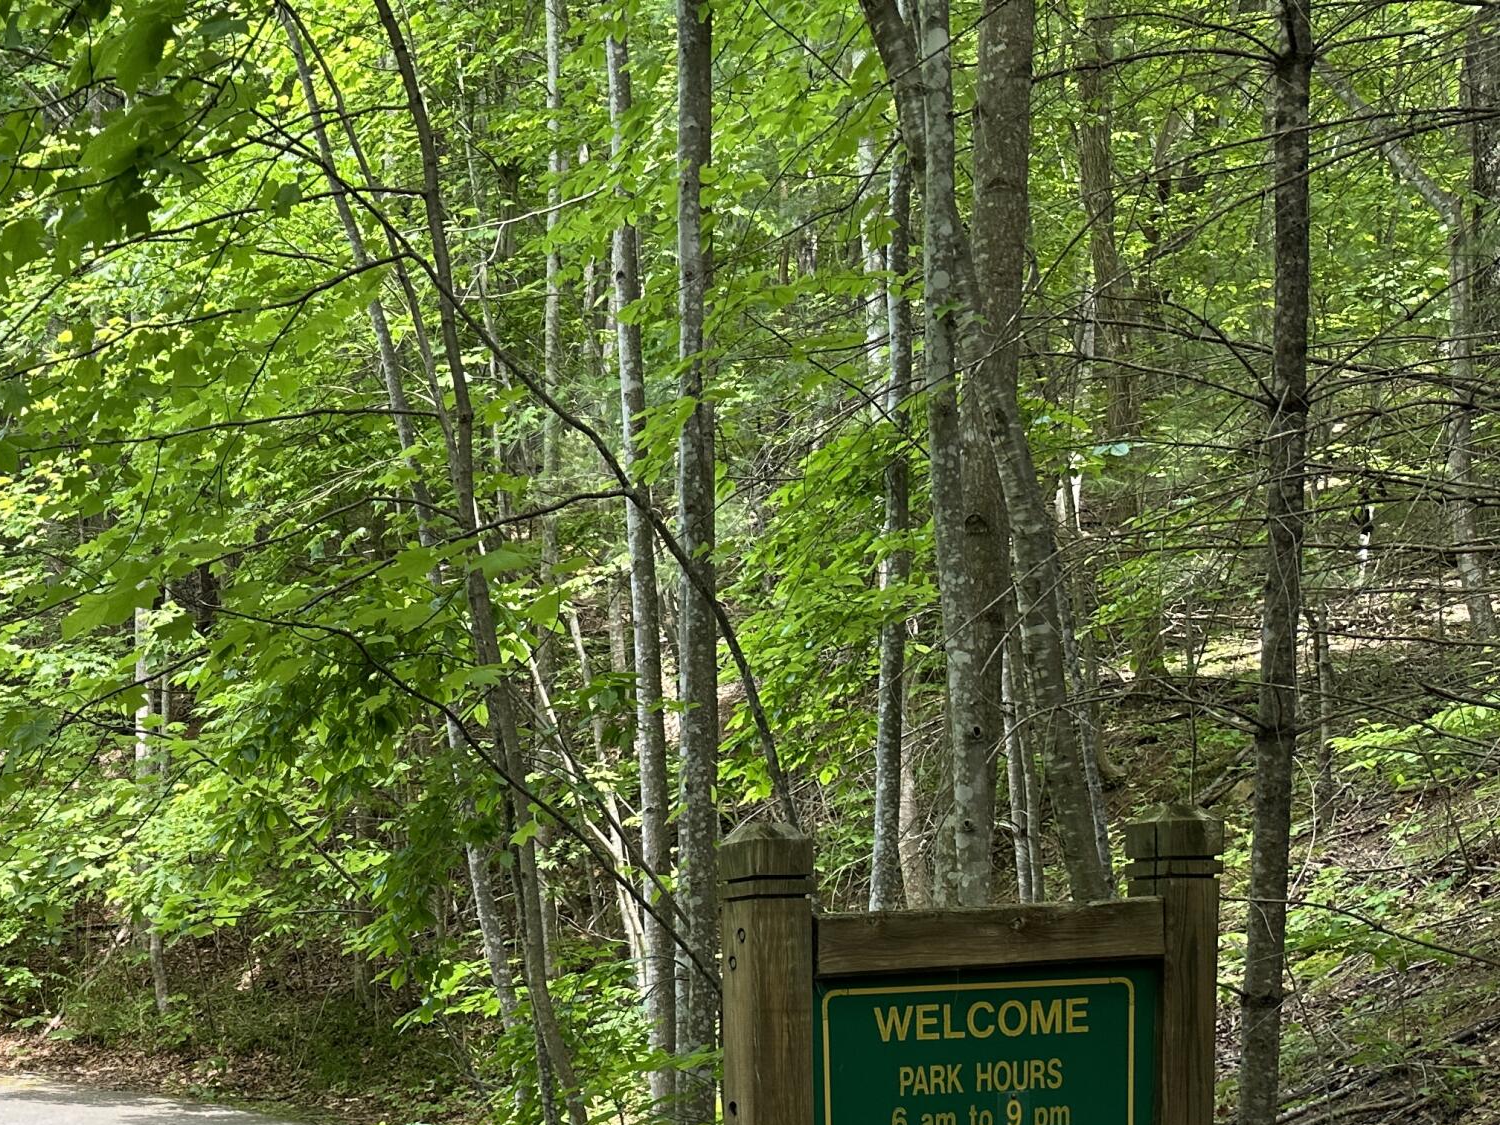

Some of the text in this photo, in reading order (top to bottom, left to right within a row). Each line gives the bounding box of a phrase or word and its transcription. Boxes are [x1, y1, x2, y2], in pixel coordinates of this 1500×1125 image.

[873, 997, 1089, 1042] WELCOME
[899, 1058, 1063, 1097] PARK HOURS
